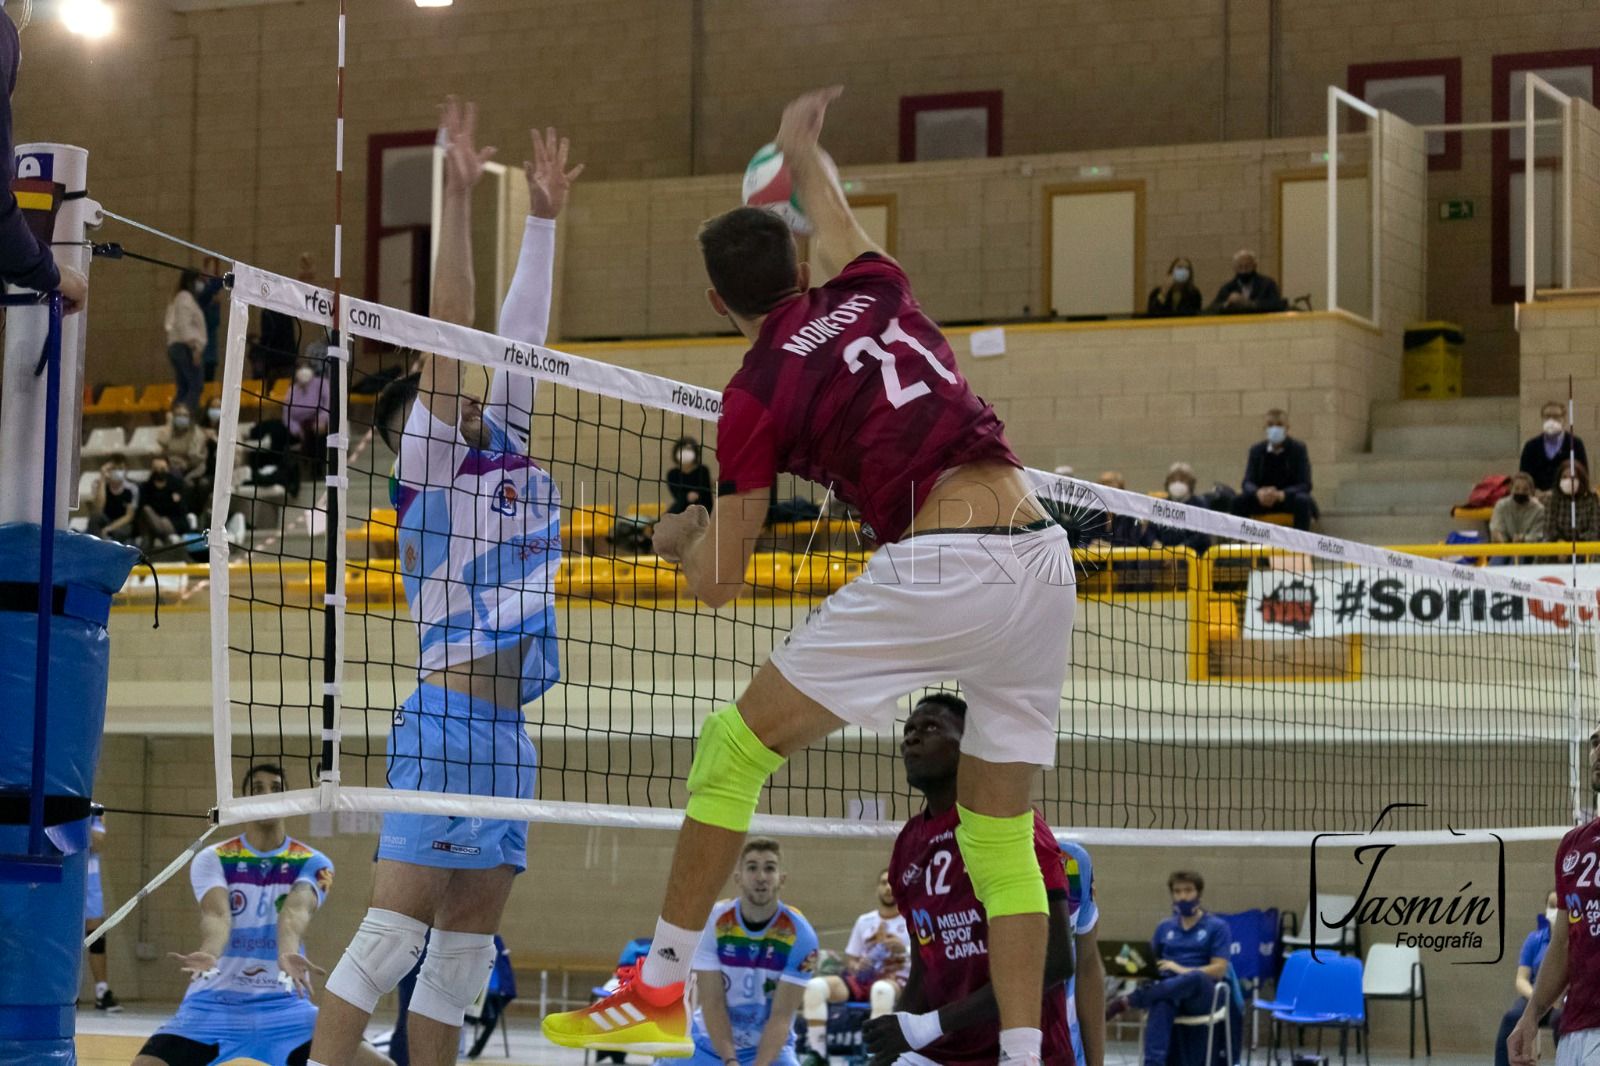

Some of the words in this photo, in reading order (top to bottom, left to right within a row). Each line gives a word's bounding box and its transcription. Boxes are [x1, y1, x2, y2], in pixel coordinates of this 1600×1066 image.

[781, 293, 878, 357] MONFORT
[503, 345, 570, 376] rfevb.com
[842, 317, 958, 410] 21
[925, 849, 953, 896] 12
